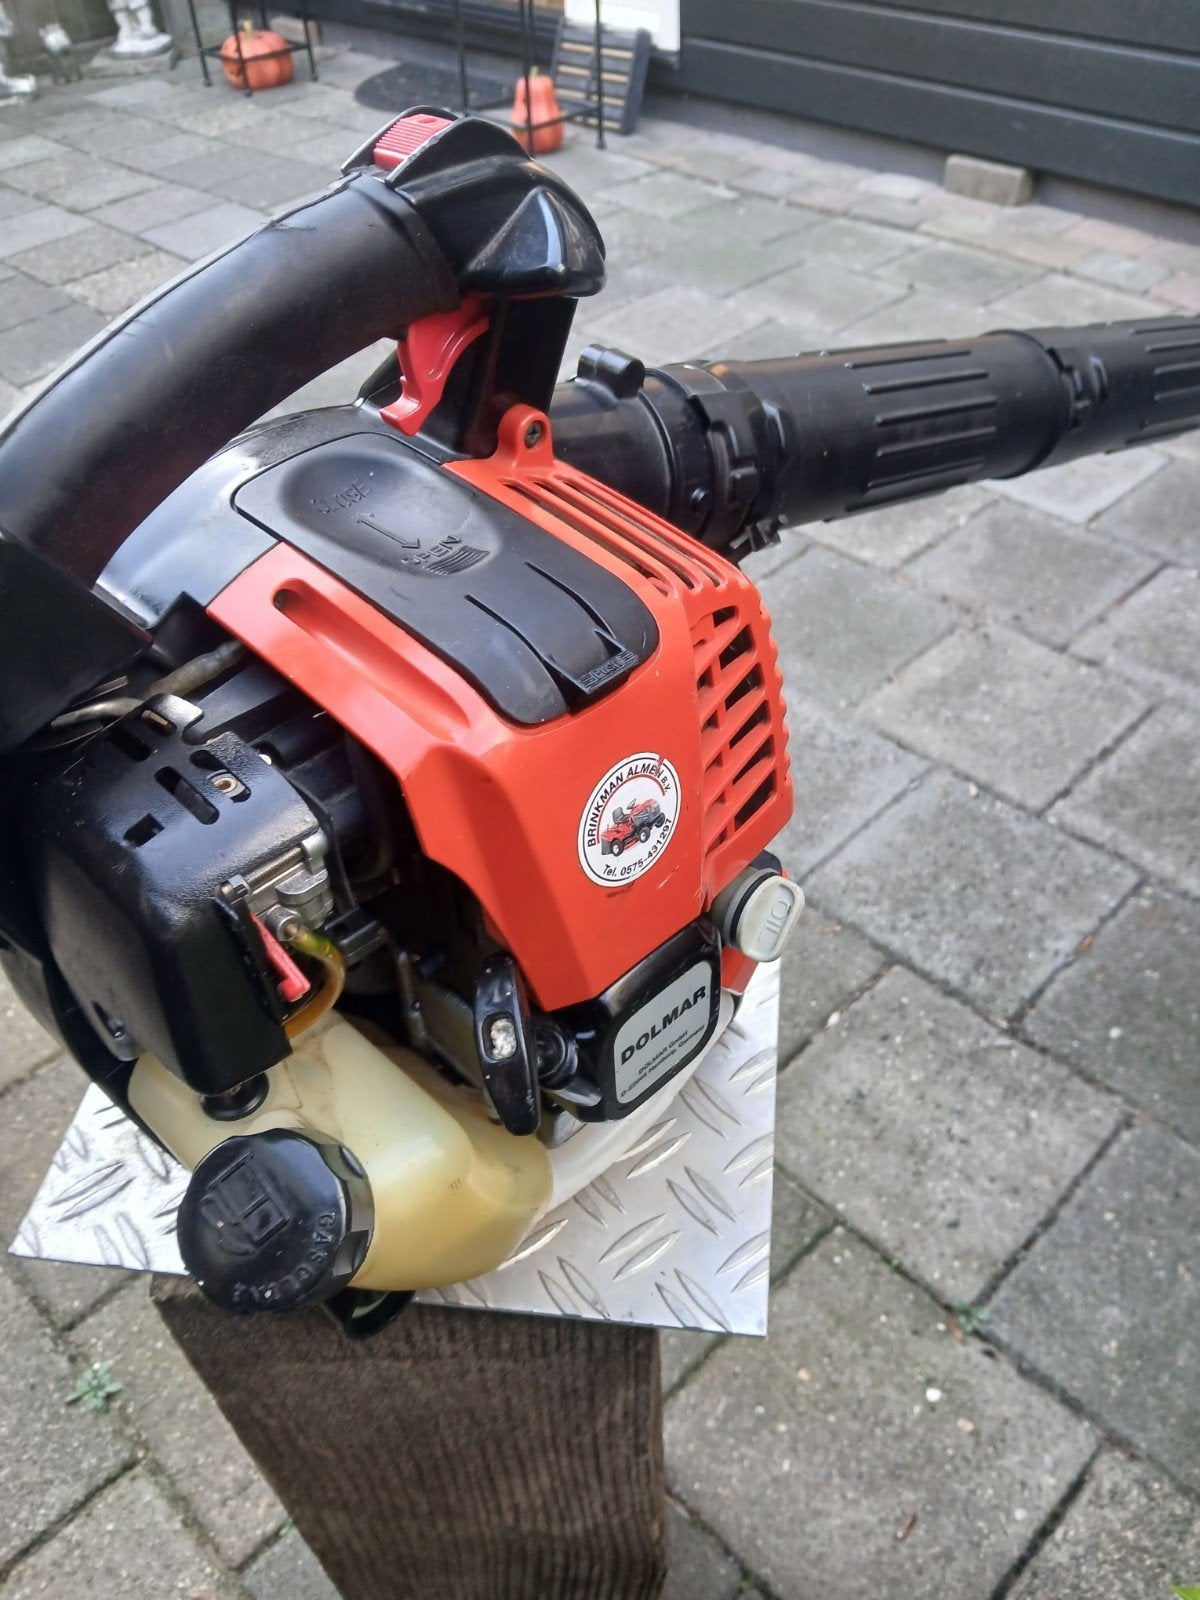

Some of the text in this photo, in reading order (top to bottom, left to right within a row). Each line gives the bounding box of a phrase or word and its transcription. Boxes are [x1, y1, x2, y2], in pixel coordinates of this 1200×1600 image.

[401, 535, 463, 565] OPEN
[587, 772, 624, 848] BRINKMAN
[626, 762, 664, 779] ALMEN
[602, 818, 672, 877] Tel. 0575-431297
[757, 900, 789, 943] OIL
[620, 985, 707, 1066] DOLMAR
[638, 1046, 668, 1075] DOLMAR
